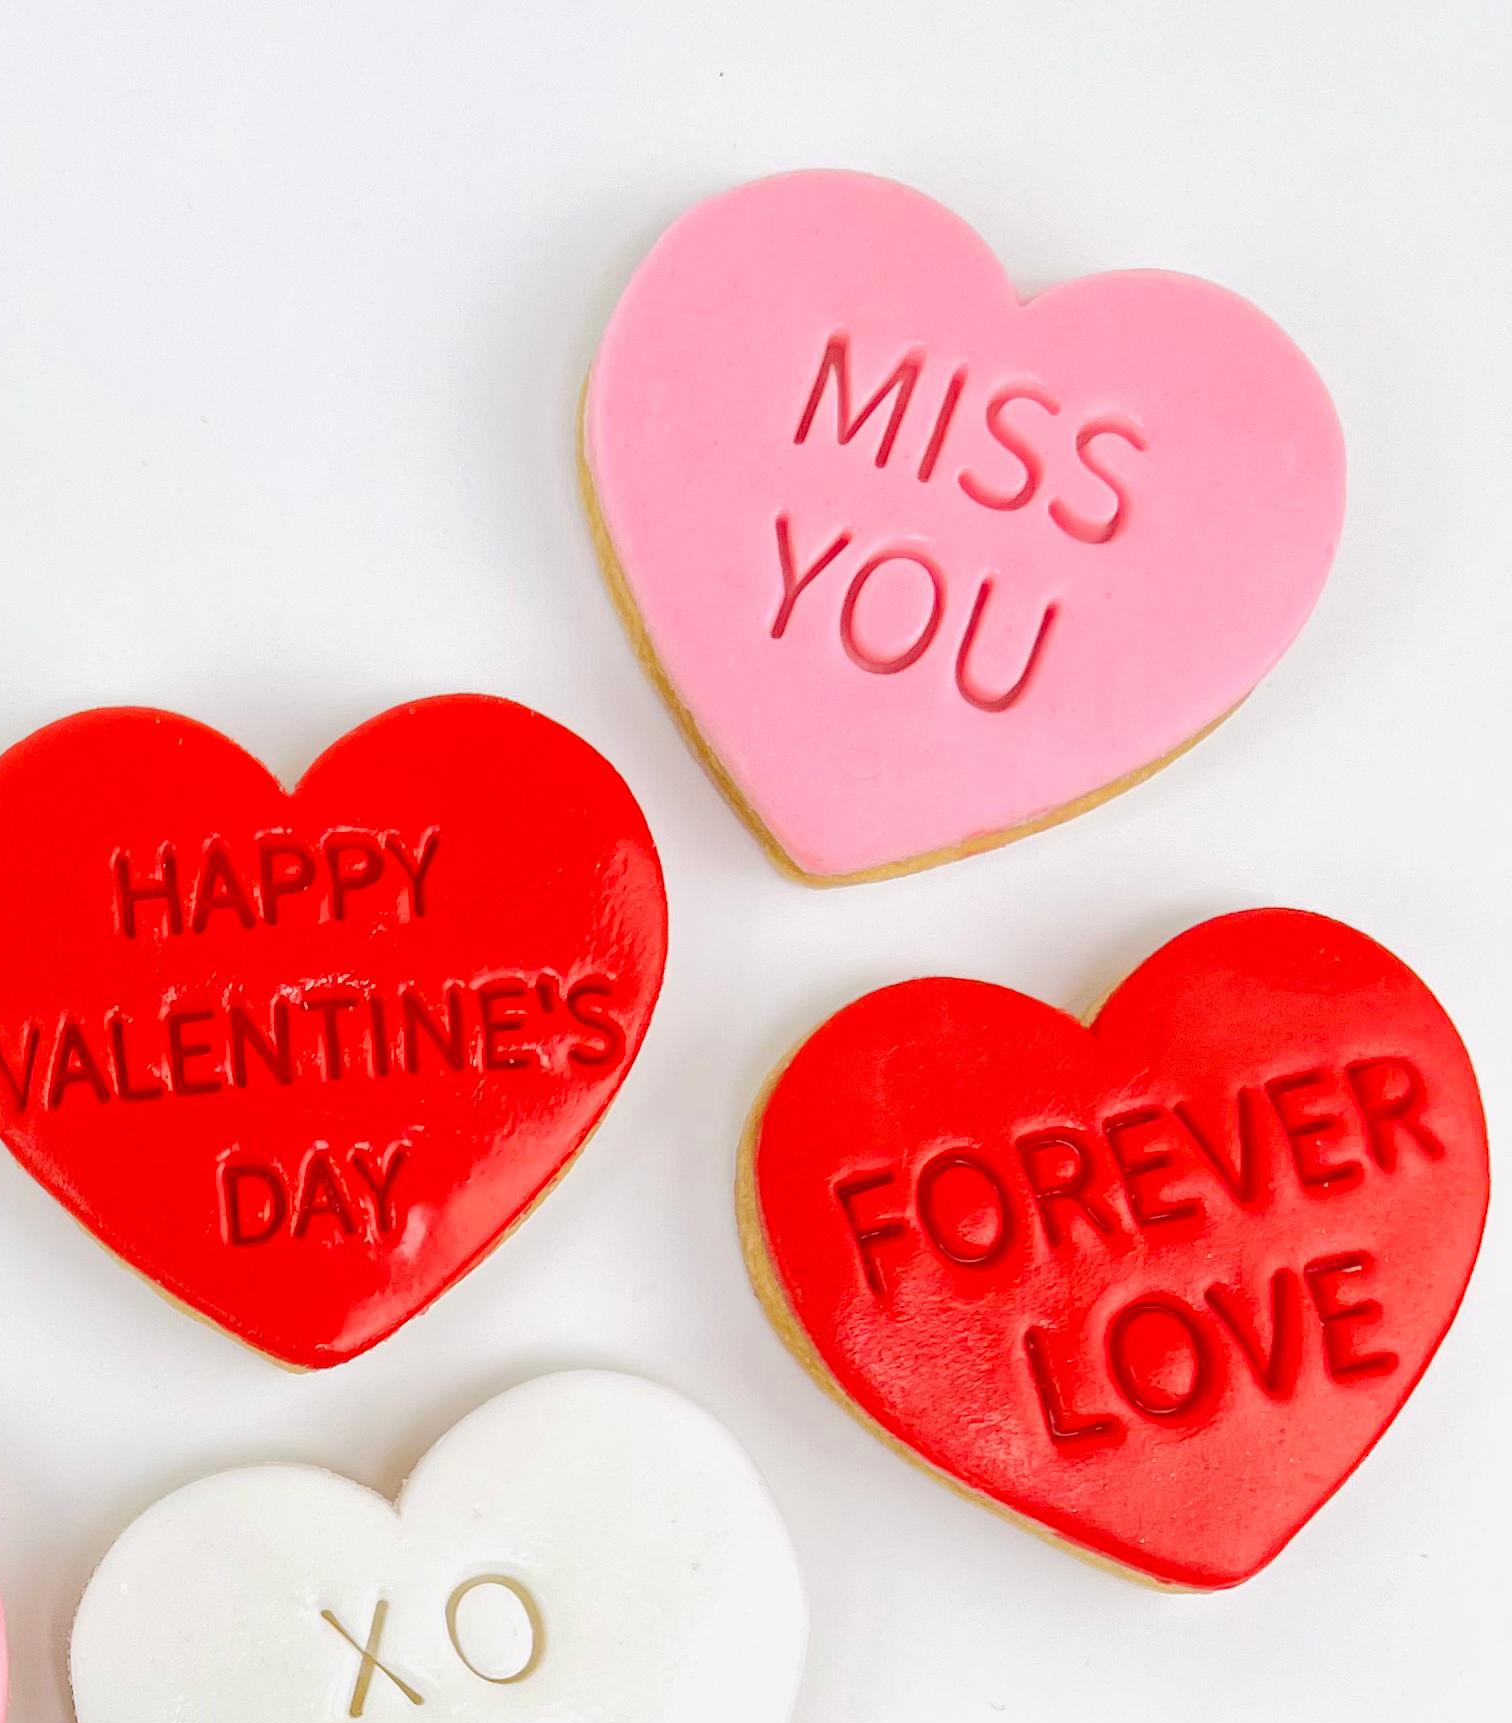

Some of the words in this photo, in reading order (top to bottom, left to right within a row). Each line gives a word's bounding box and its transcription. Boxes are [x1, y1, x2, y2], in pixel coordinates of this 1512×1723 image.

[792, 330, 1148, 545] MISS
[770, 514, 1062, 713] YOU
[115, 832, 441, 938] HAPPY
[221, 1147, 410, 1246] DAY
[834, 1056, 1443, 1298] FOREVER
[1024, 1249, 1400, 1447] LOVE
[320, 1573, 547, 1719] XO
